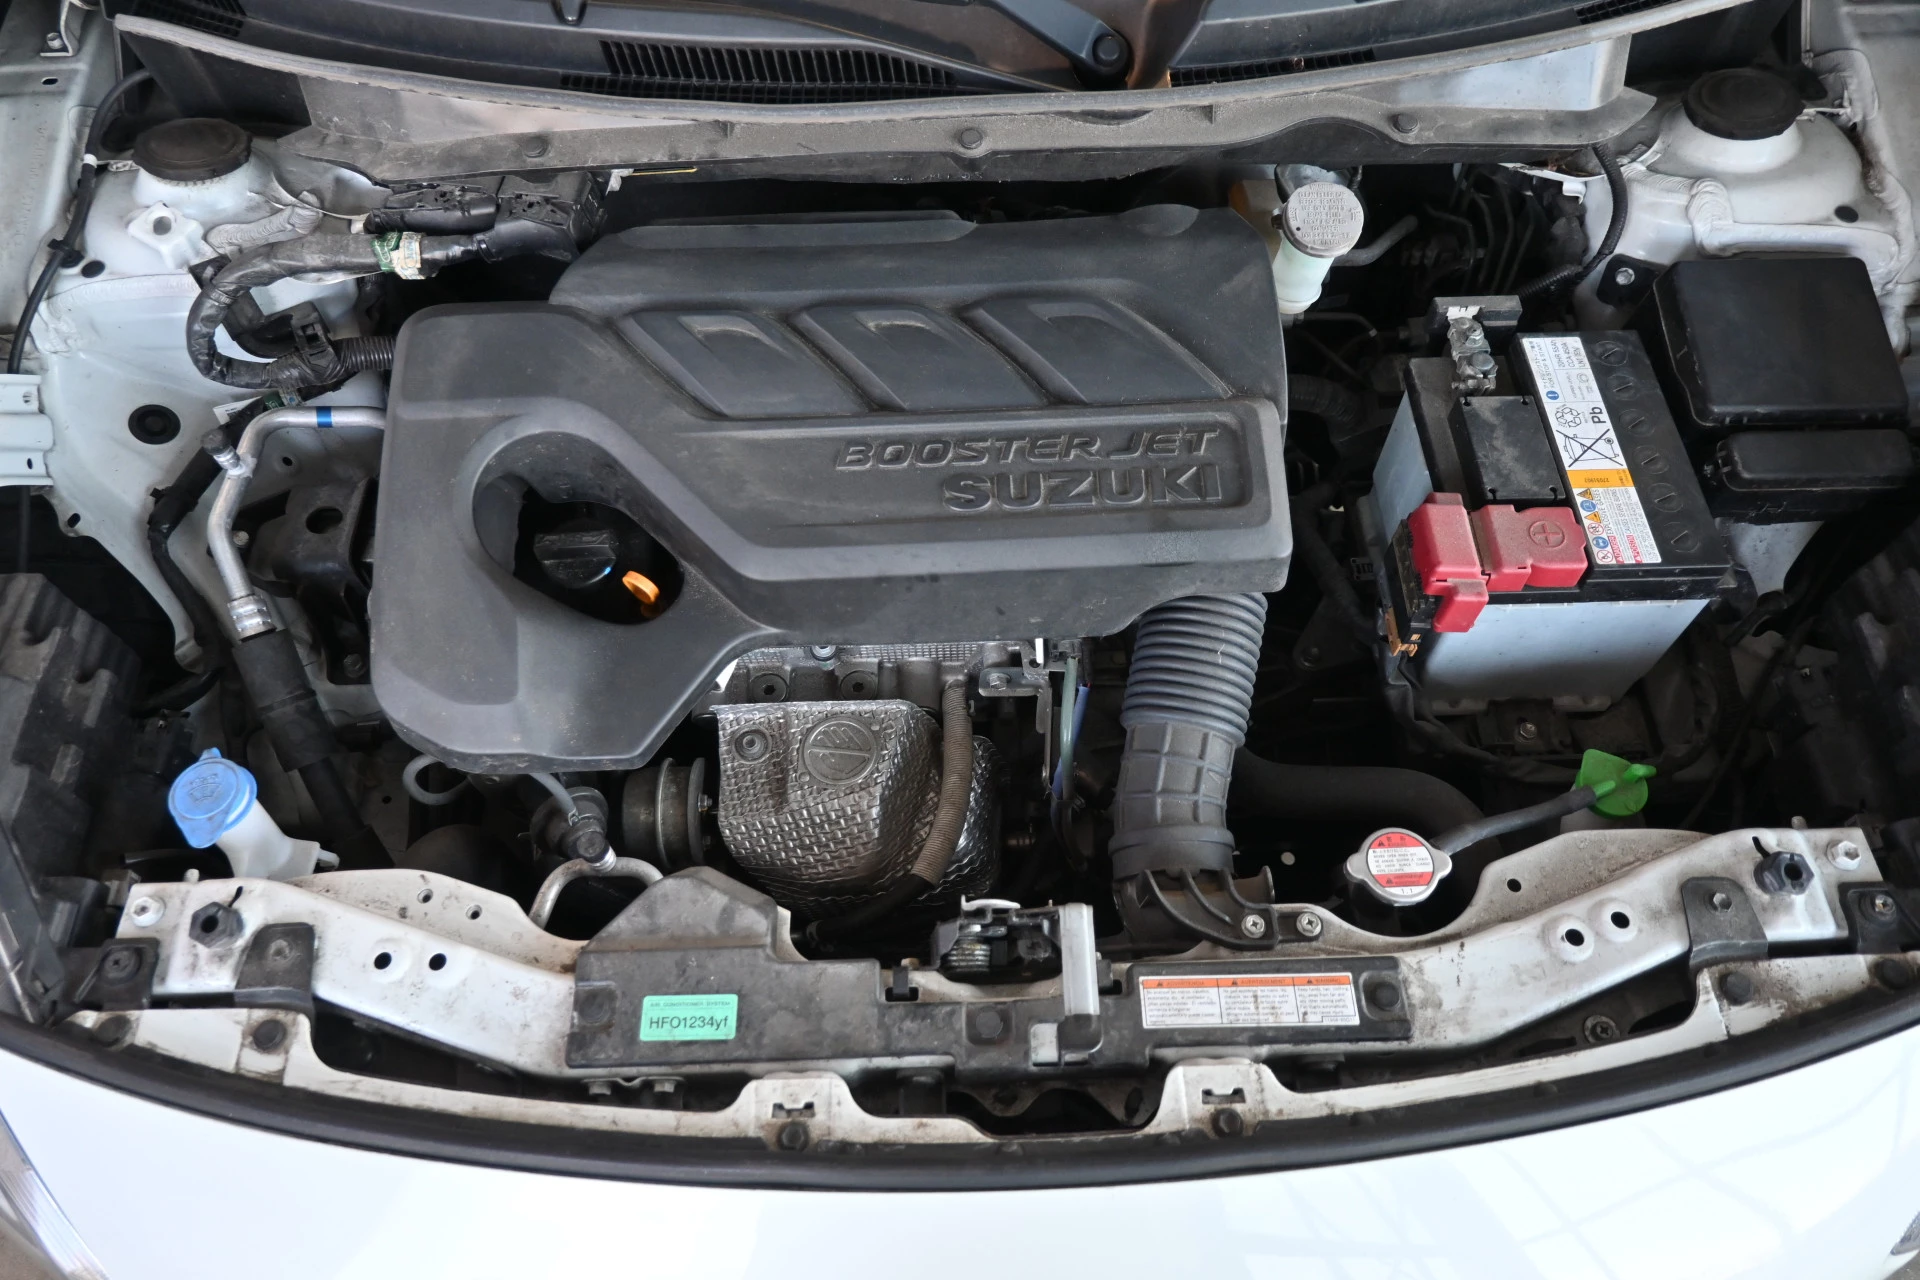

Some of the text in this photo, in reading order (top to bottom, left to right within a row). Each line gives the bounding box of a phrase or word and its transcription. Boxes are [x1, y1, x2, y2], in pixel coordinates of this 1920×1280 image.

[1589, 406, 1607, 424] Pb
[943, 464, 1222, 512] SUZUKI
[1599, 508, 1613, 534] EXPLOSIVE
[649, 1015, 729, 1031] HFO1234yf
